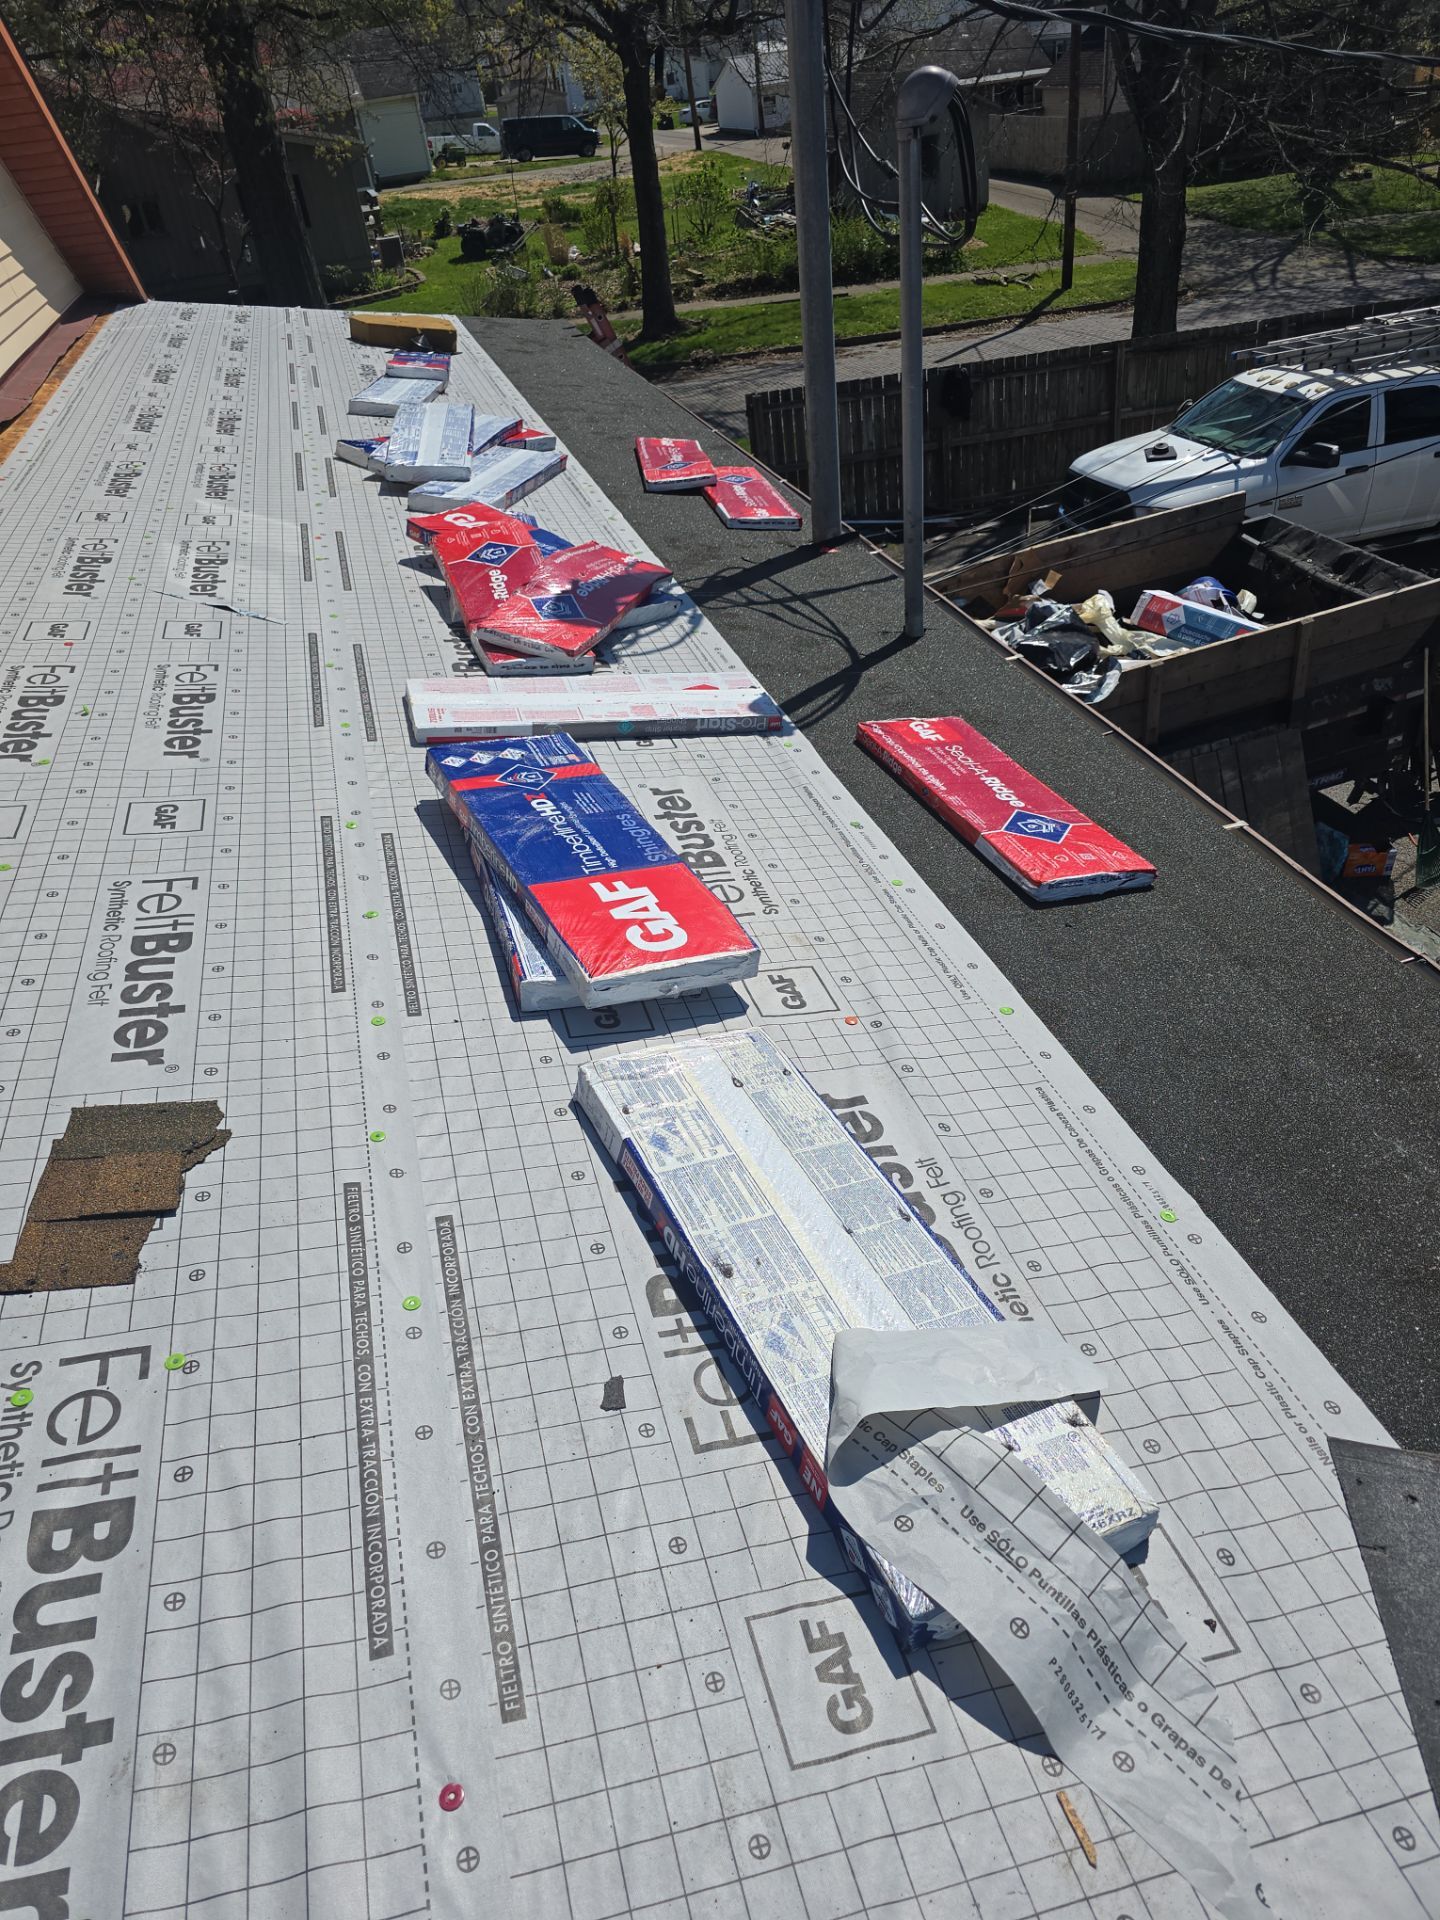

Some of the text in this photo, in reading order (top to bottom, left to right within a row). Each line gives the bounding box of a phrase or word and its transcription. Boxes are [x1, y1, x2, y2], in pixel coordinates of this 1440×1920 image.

[104, 461, 146, 497] FeltBuster
[205, 463, 237, 500] FeltBuster
[62, 538, 119, 598] FeltBuster
[190, 540, 230, 597] FeltBuster
[47, 623, 69, 639] GAF
[184, 623, 202, 638] GAF
[0, 664, 76, 762] FeltBuster
[163, 664, 219, 759] FeltBuster
[696, 718, 766, 732] Pro-Start
[909, 721, 945, 741] GAF
[945, 745, 1026, 808] Seal-A-Ridge
[153, 804, 179, 830] GAF
[616, 813, 668, 862] Shingles
[709, 818, 779, 915] Synthetic Roofing Felt
[589, 880, 688, 951] GAF
[87, 880, 132, 1006] Synthetic Roofing Felt
[110, 877, 199, 1065] FeltBuster
[767, 973, 807, 1010] GAF
[1055, 1110, 1080, 1139] Cabeza
[1074, 1136, 1088, 1150] De
[916, 1156, 951, 1190] Felt
[1083, 1147, 1110, 1177] Grapas
[943, 1192, 1001, 1270] Roofing
[1139, 1218, 1173, 1259] Puntillas
[1167, 1255, 1197, 1289] SÓLO
[1190, 1285, 1210, 1307] Use
[1215, 1316, 1250, 1358] Staples
[1245, 1355, 1268, 1380] Cap
[347, 1186, 390, 1649] FIELTRO SINTÉTICO PARA TECHOS, CON EXTRA-TRACCIÓN INCORPORADA
[1262, 1379, 1297, 1421] Plastic
[770, 1407, 793, 1446] GAF
[1292, 1418, 1309, 1435] or
[438, 1220, 521, 1712] FIELTRO SINTÉTICO PARA TECHOS, CON EXTRA-TRACCIÓN INCORPORADA
[873, 1431, 898, 1453] Cap
[899, 1448, 945, 1493] Staples
[960, 1504, 986, 1533] Use
[983, 1527, 1029, 1572] SÓLO
[1028, 1568, 1087, 1630] Puntillas
[1086, 1628, 1136, 1702] Plásticas
[1137, 1701, 1149, 1713] o
[1150, 1711, 1206, 1767] Grapas
[1208, 1766, 1233, 1790] De
[801, 1619, 874, 1736] GAF
[1048, 1657, 1106, 1741] P2808325171
